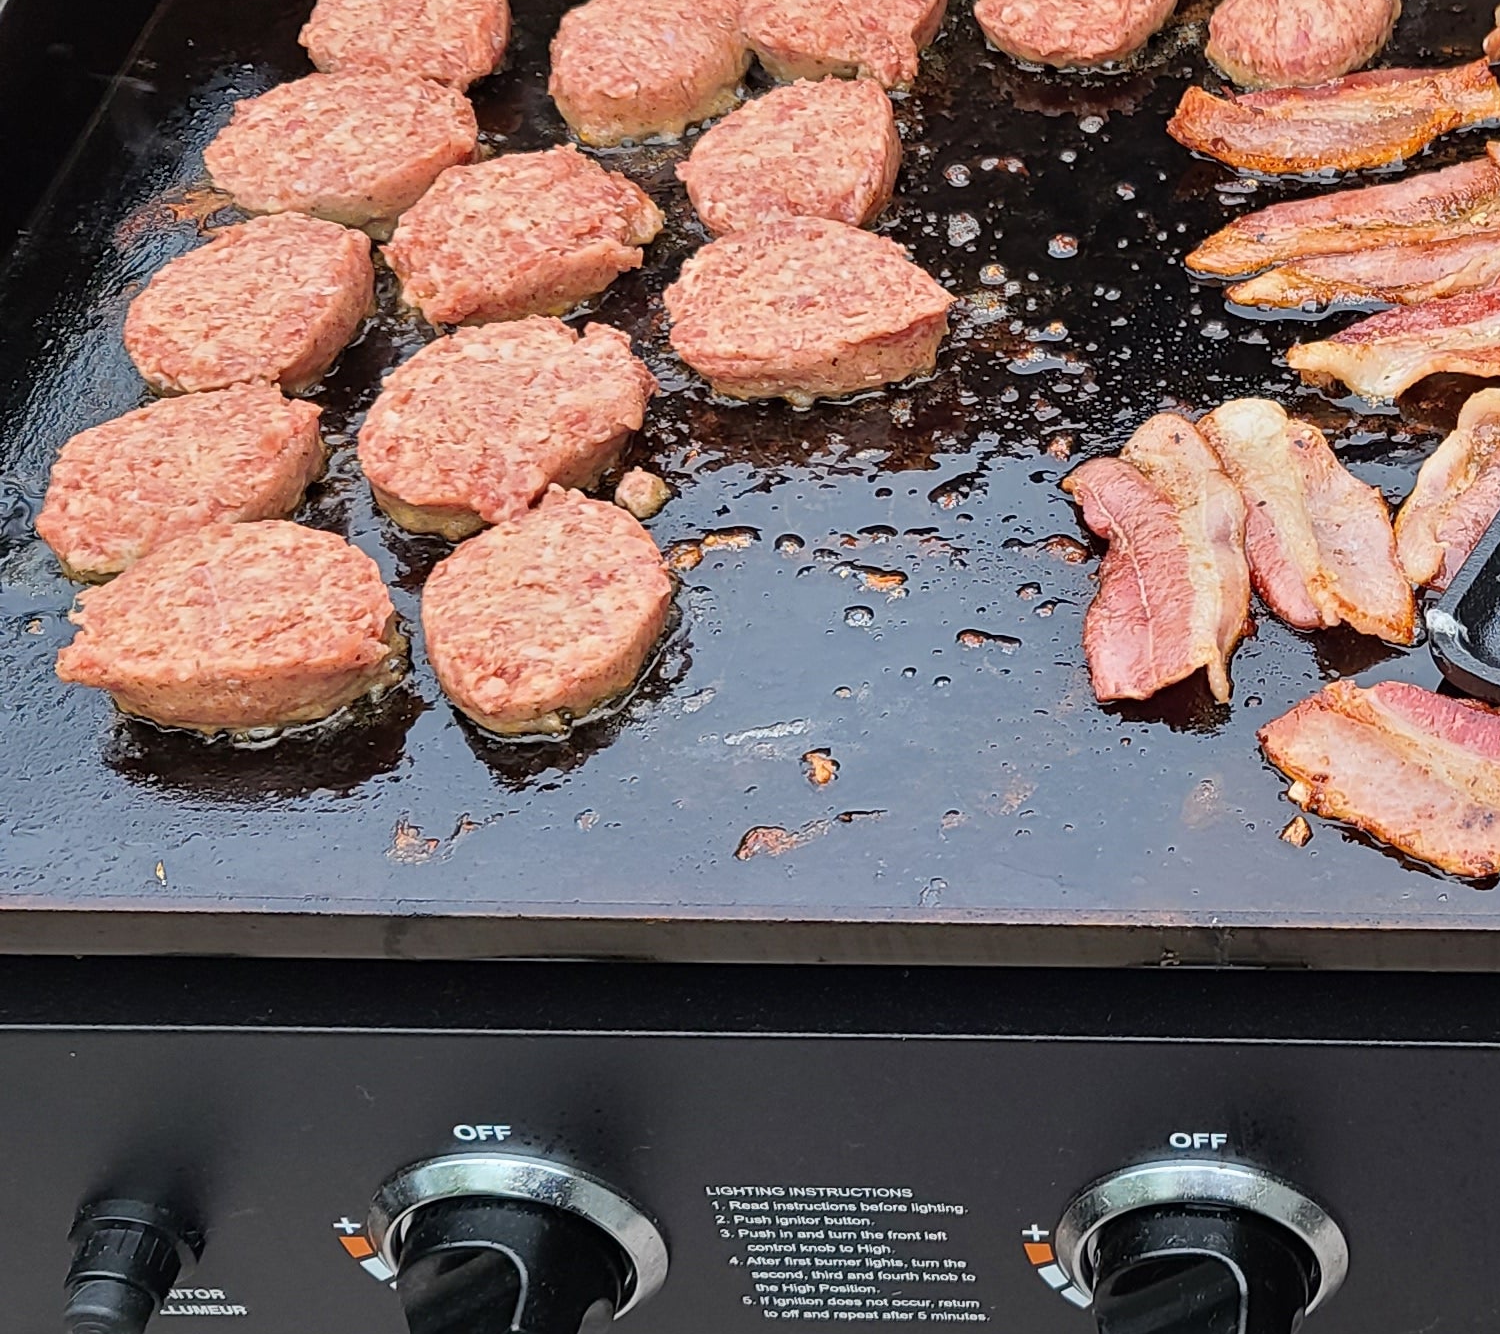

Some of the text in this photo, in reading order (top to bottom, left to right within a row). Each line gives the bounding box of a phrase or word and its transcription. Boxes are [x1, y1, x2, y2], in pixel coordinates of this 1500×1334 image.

[453, 1123, 512, 1142] OFF
[1168, 1131, 1229, 1150] OFF
[706, 1186, 913, 1199] LIGHTING INSTRUCTIONS
[712, 1201, 969, 1215] 1. Read instructions before lighting.
[716, 1215, 876, 1227] 2. Push ignitor button.
[720, 1229, 948, 1241] 3. Push in and turn the front left
[747, 1243, 896, 1255] control knob to High.
[728, 1256, 967, 1269] 4. After first burner lights, turn the
[751, 1270, 976, 1282] second, third and fourth knob to
[164, 1288, 226, 1300] NITOR
[754, 1284, 881, 1295] the High Position.
[760, 1297, 771, 1306] If
[773, 1297, 824, 1307] ignition
[828, 1297, 862, 1307] does
[866, 1298, 889, 1307] not
[892, 1299, 935, 1309] occur,
[938, 1299, 980, 1309] return
[158, 1304, 248, 1316] LLUMEUR
[763, 1309, 778, 1319] to
[782, 1309, 800, 1319] off
[803, 1310, 830, 1319] and
[833, 1311, 879, 1321] repeat
[882, 1311, 914, 1320] after
[930, 1311, 990, 1322] minutes.
